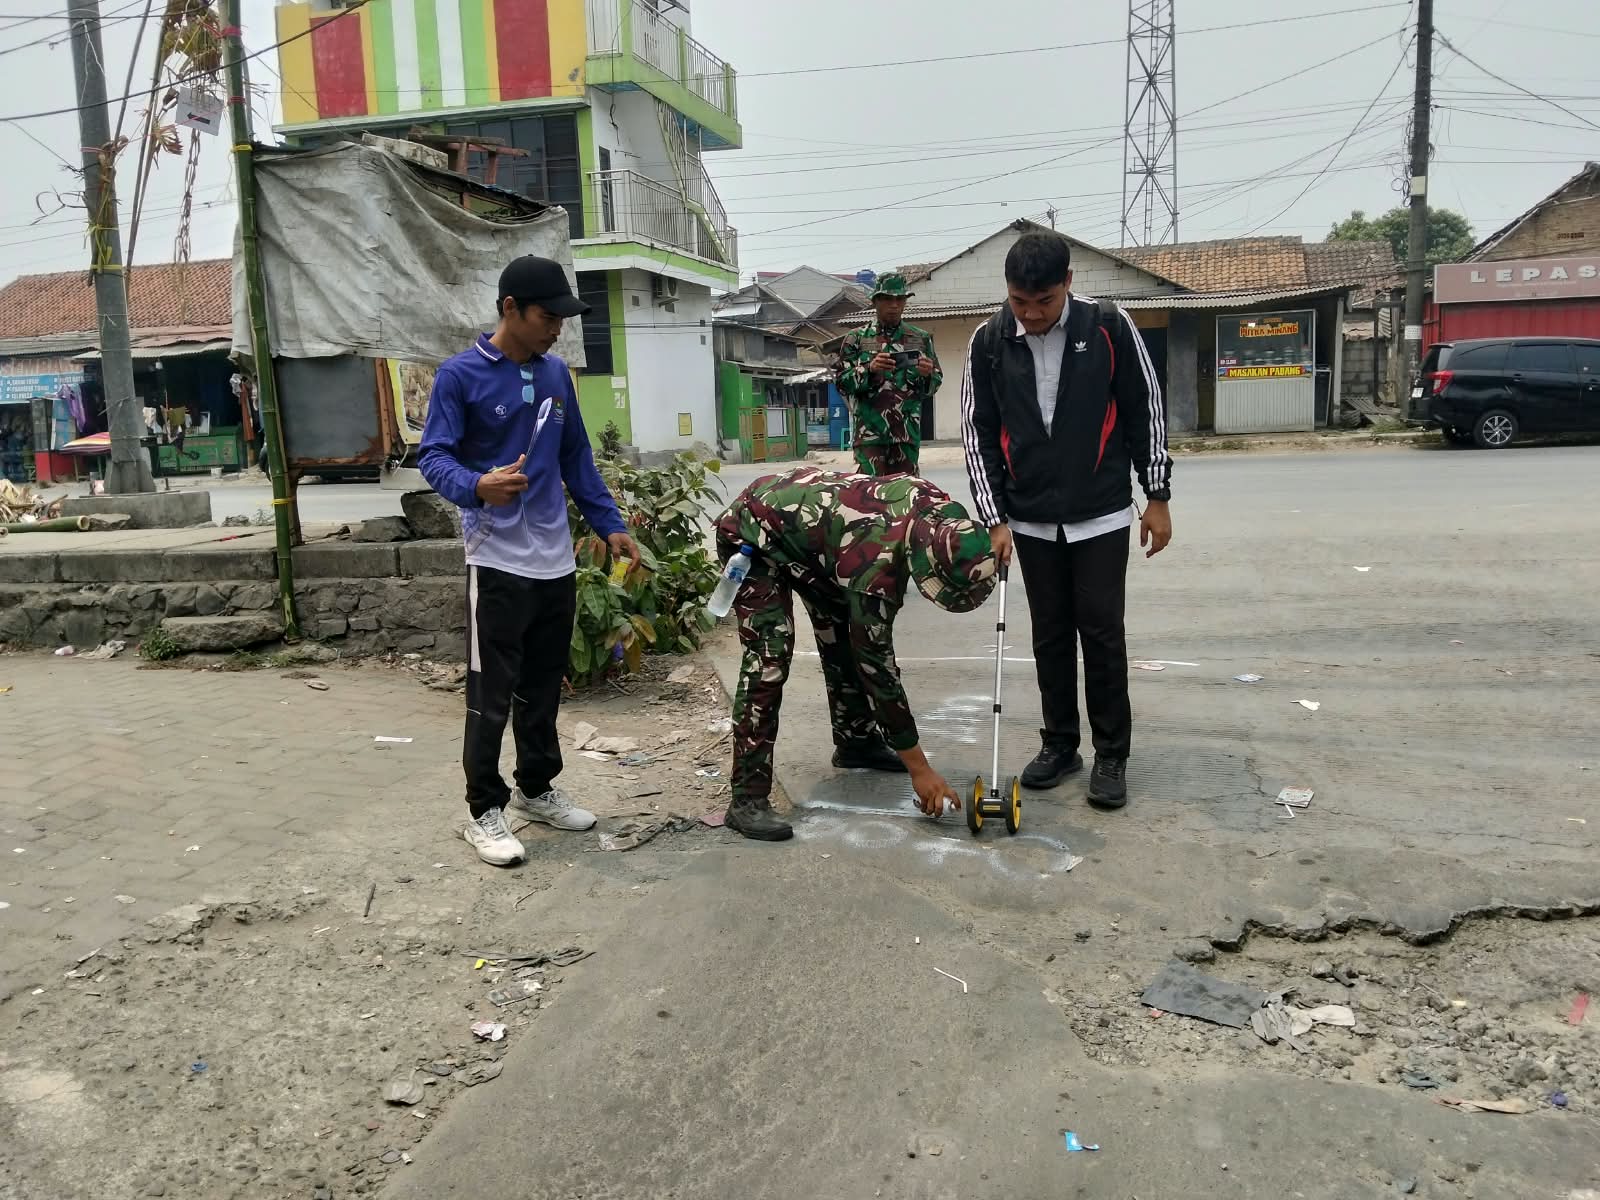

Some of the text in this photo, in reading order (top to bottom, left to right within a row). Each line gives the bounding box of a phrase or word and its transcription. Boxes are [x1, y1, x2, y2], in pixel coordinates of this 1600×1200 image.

[1267, 324, 1298, 335] MINANG
[1229, 366, 1301, 377] MASAKAN PADANG
